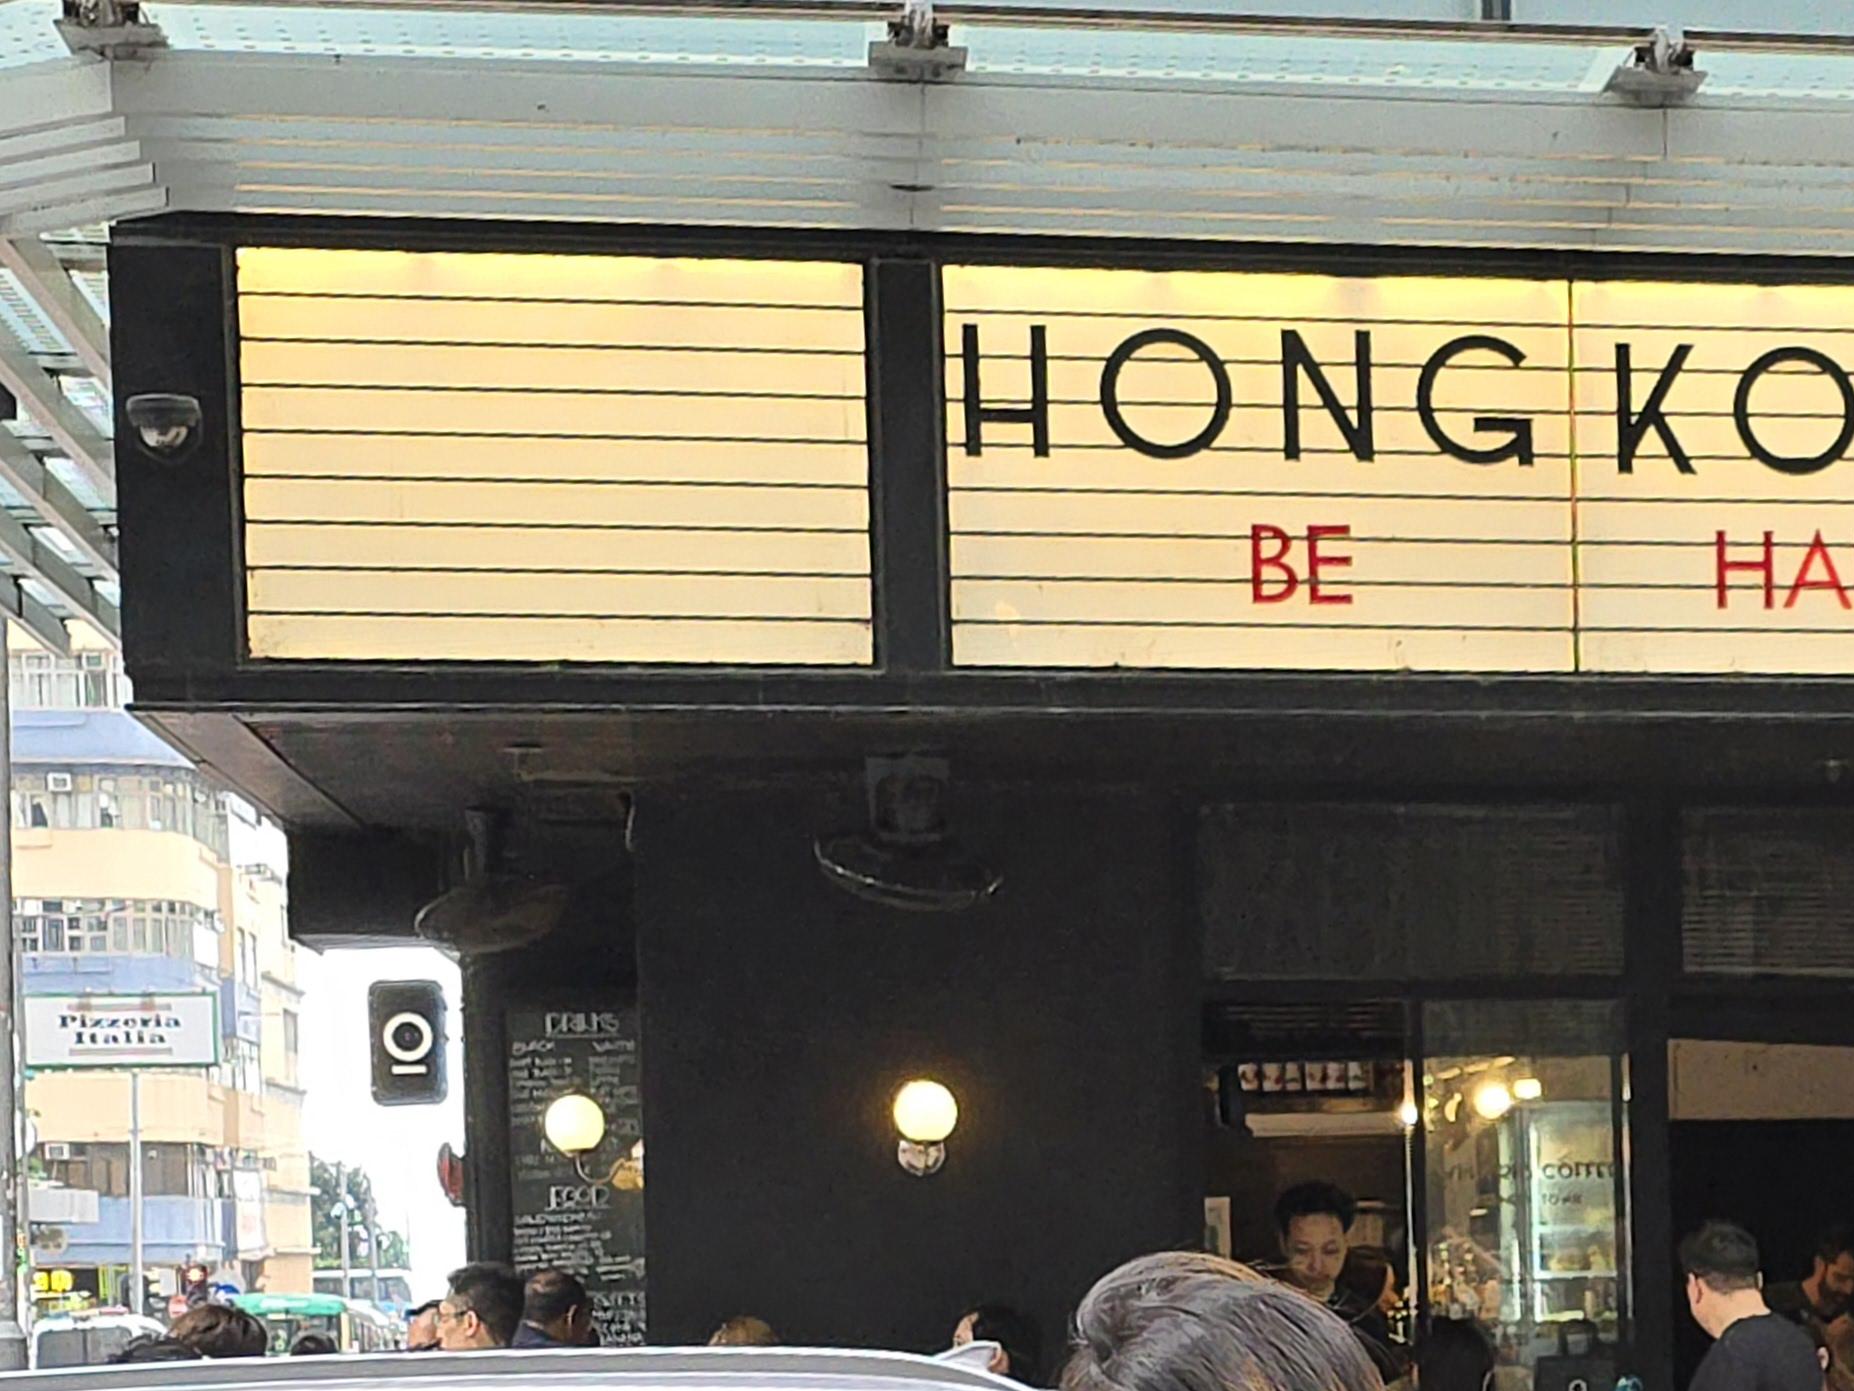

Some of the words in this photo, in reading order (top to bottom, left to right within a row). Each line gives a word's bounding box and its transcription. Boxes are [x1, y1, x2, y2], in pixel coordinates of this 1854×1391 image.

[962, 324, 1533, 466] HONG
[1250, 523, 1353, 605] BE
[58, 1014, 181, 1029] Pizzeria
[74, 1031, 166, 1044] Italia
